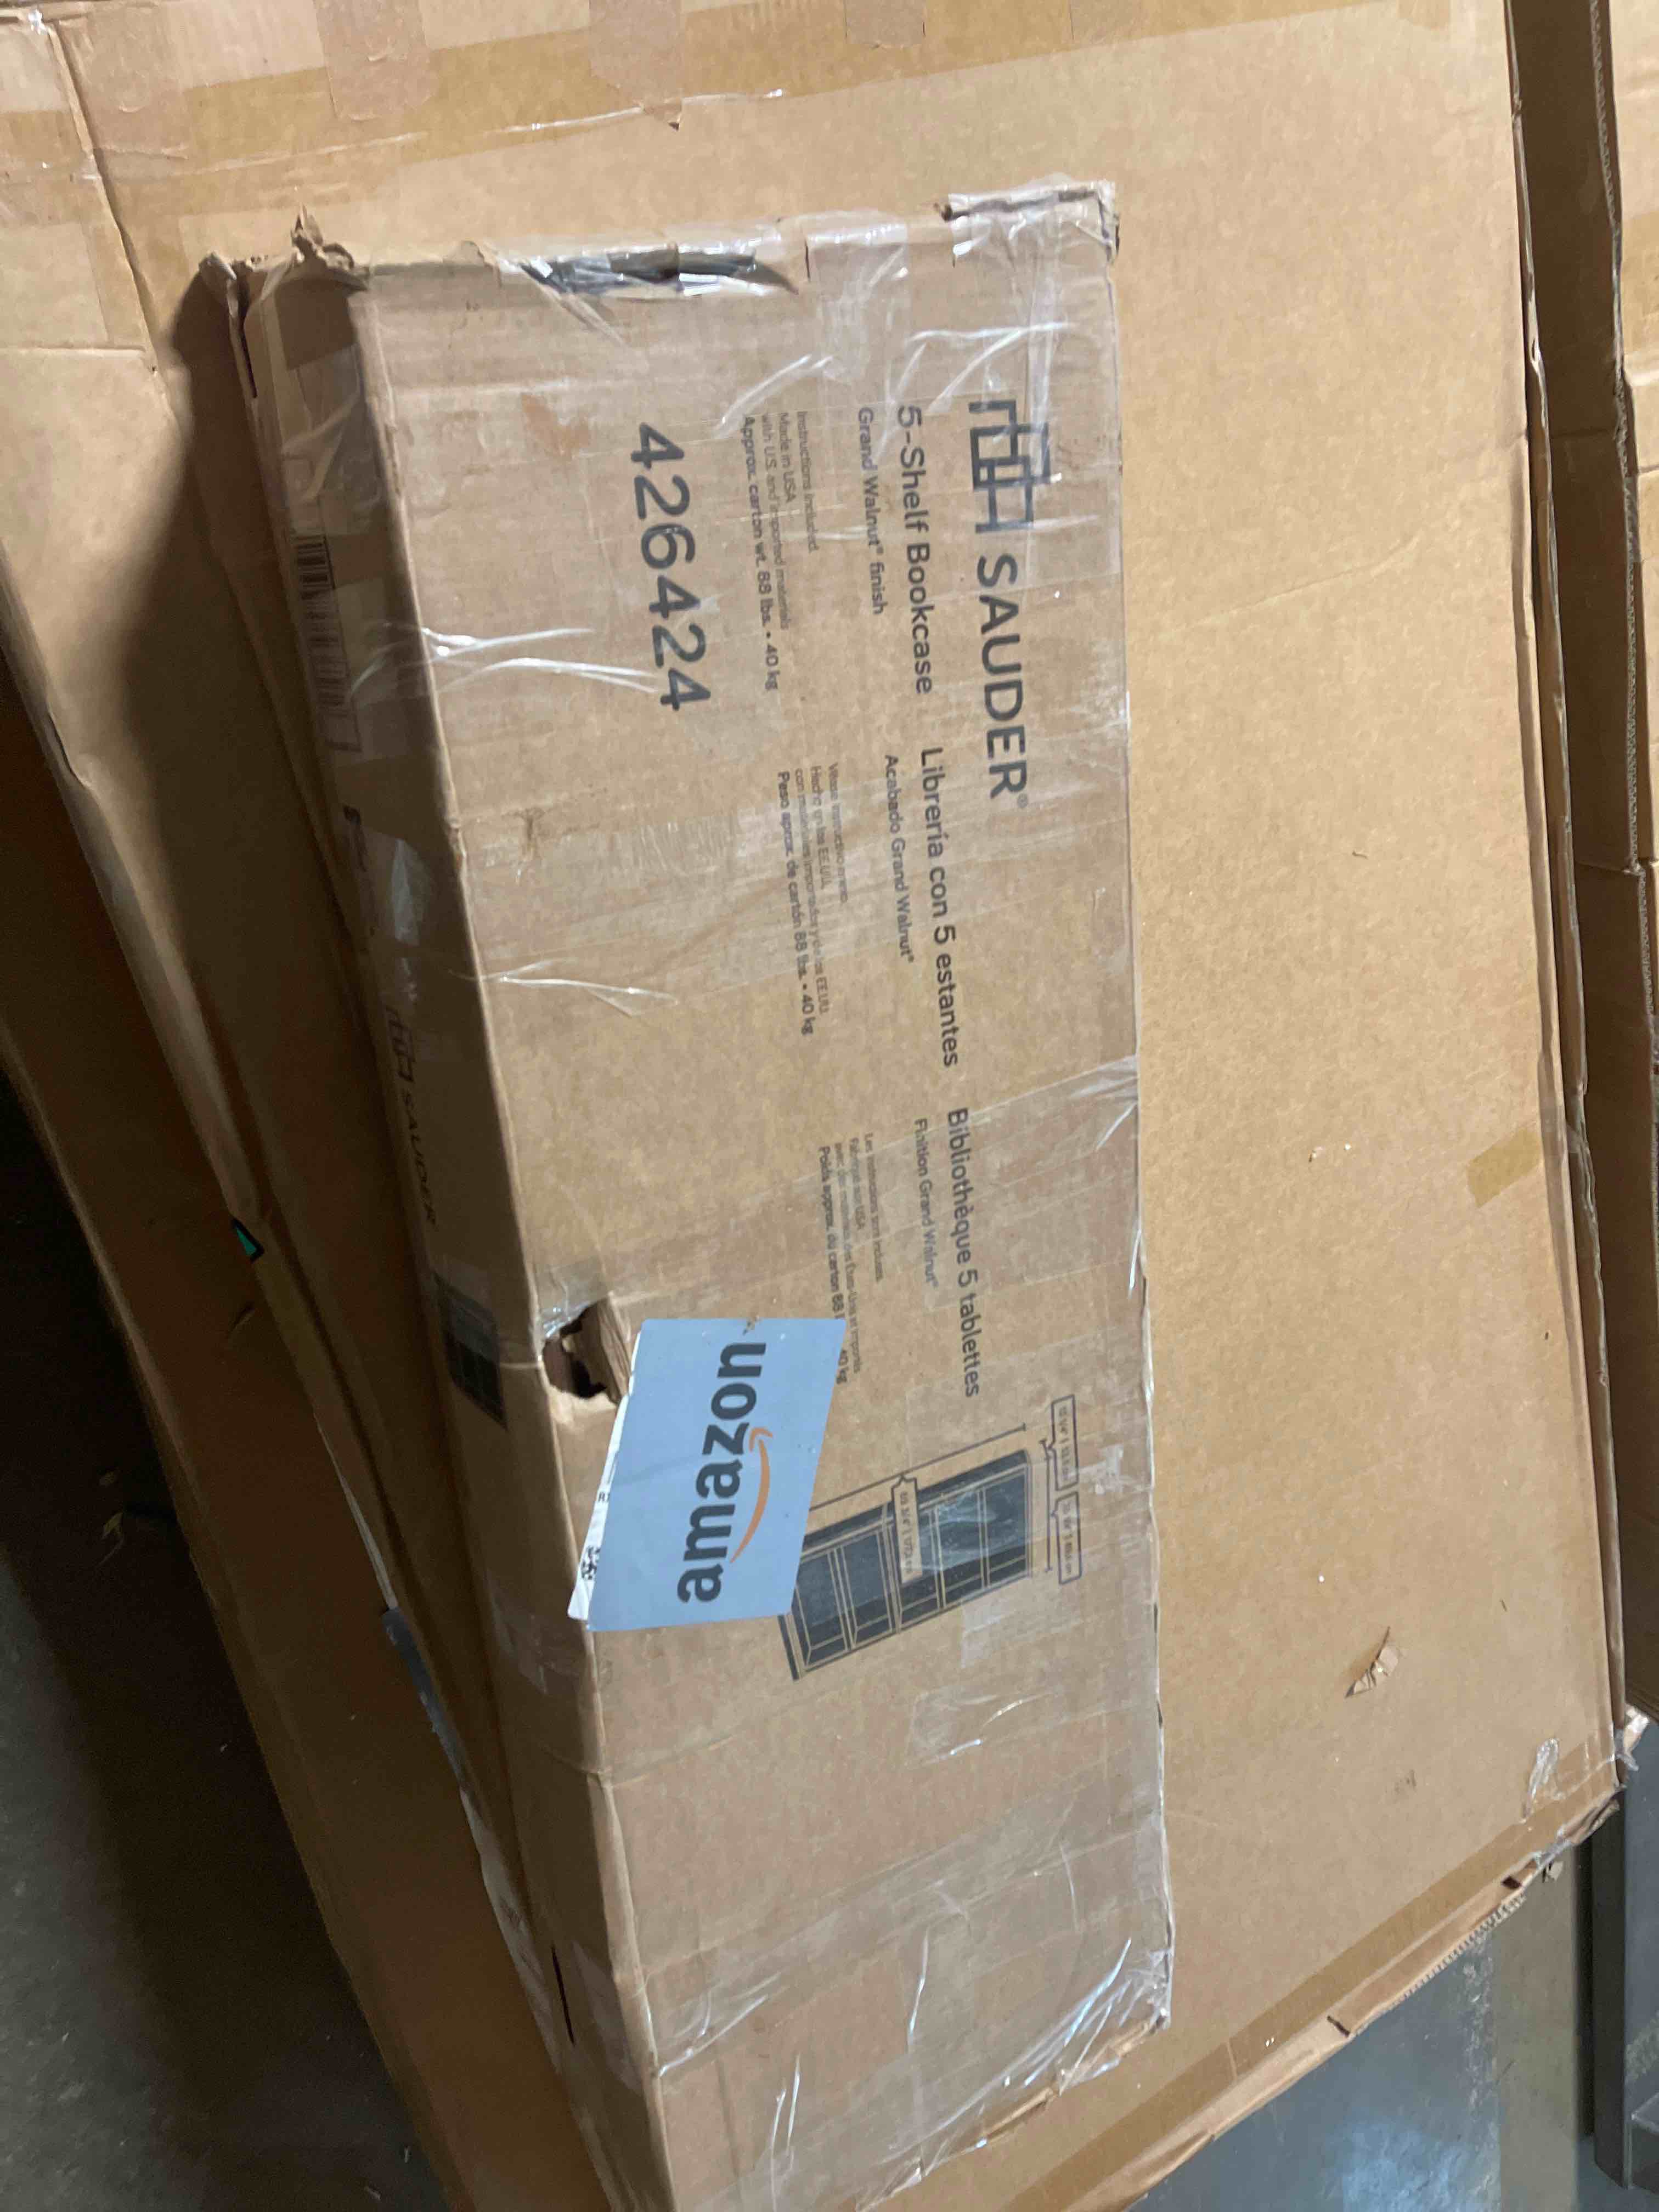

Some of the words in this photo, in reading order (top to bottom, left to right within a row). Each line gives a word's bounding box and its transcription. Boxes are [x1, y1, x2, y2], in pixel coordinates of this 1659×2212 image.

[740, 417, 755, 482] Approx.
[779, 413, 792, 451] Made
[781, 455, 792, 468] in
[898, 405, 929, 532] 5-Shelf
[766, 475, 781, 500] and
[783, 471, 797, 503] USA
[749, 484, 763, 539] carton
[858, 407, 877, 469] Grand
[869, 562, 887, 614] finish
[630, 422, 712, 712] 426424
[757, 571, 772, 595] 88
[760, 598, 774, 628] lbs.
[906, 543, 935, 694] Bookcase
[765, 644, 779, 667] 40
[764, 670, 781, 691] kg
[777, 771, 791, 809] Peso
[884, 754, 904, 834] Acabado
[921, 748, 949, 858] Librería
[787, 860, 799, 878] de
[891, 838, 909, 892] Grand
[929, 867, 949, 919] con
[794, 931, 808, 952] 88
[933, 924, 956, 944] 5
[802, 994, 814, 1014] 40
[935, 953, 960, 1068] estantes
[801, 1017, 816, 1036] kg
[918, 1180, 934, 1227] Grand
[948, 1108, 976, 1265] Bibliothèque
[957, 1269, 979, 1288] 5
[959, 1293, 982, 1398] tablettes
[676, 1342, 766, 1604] amazon
